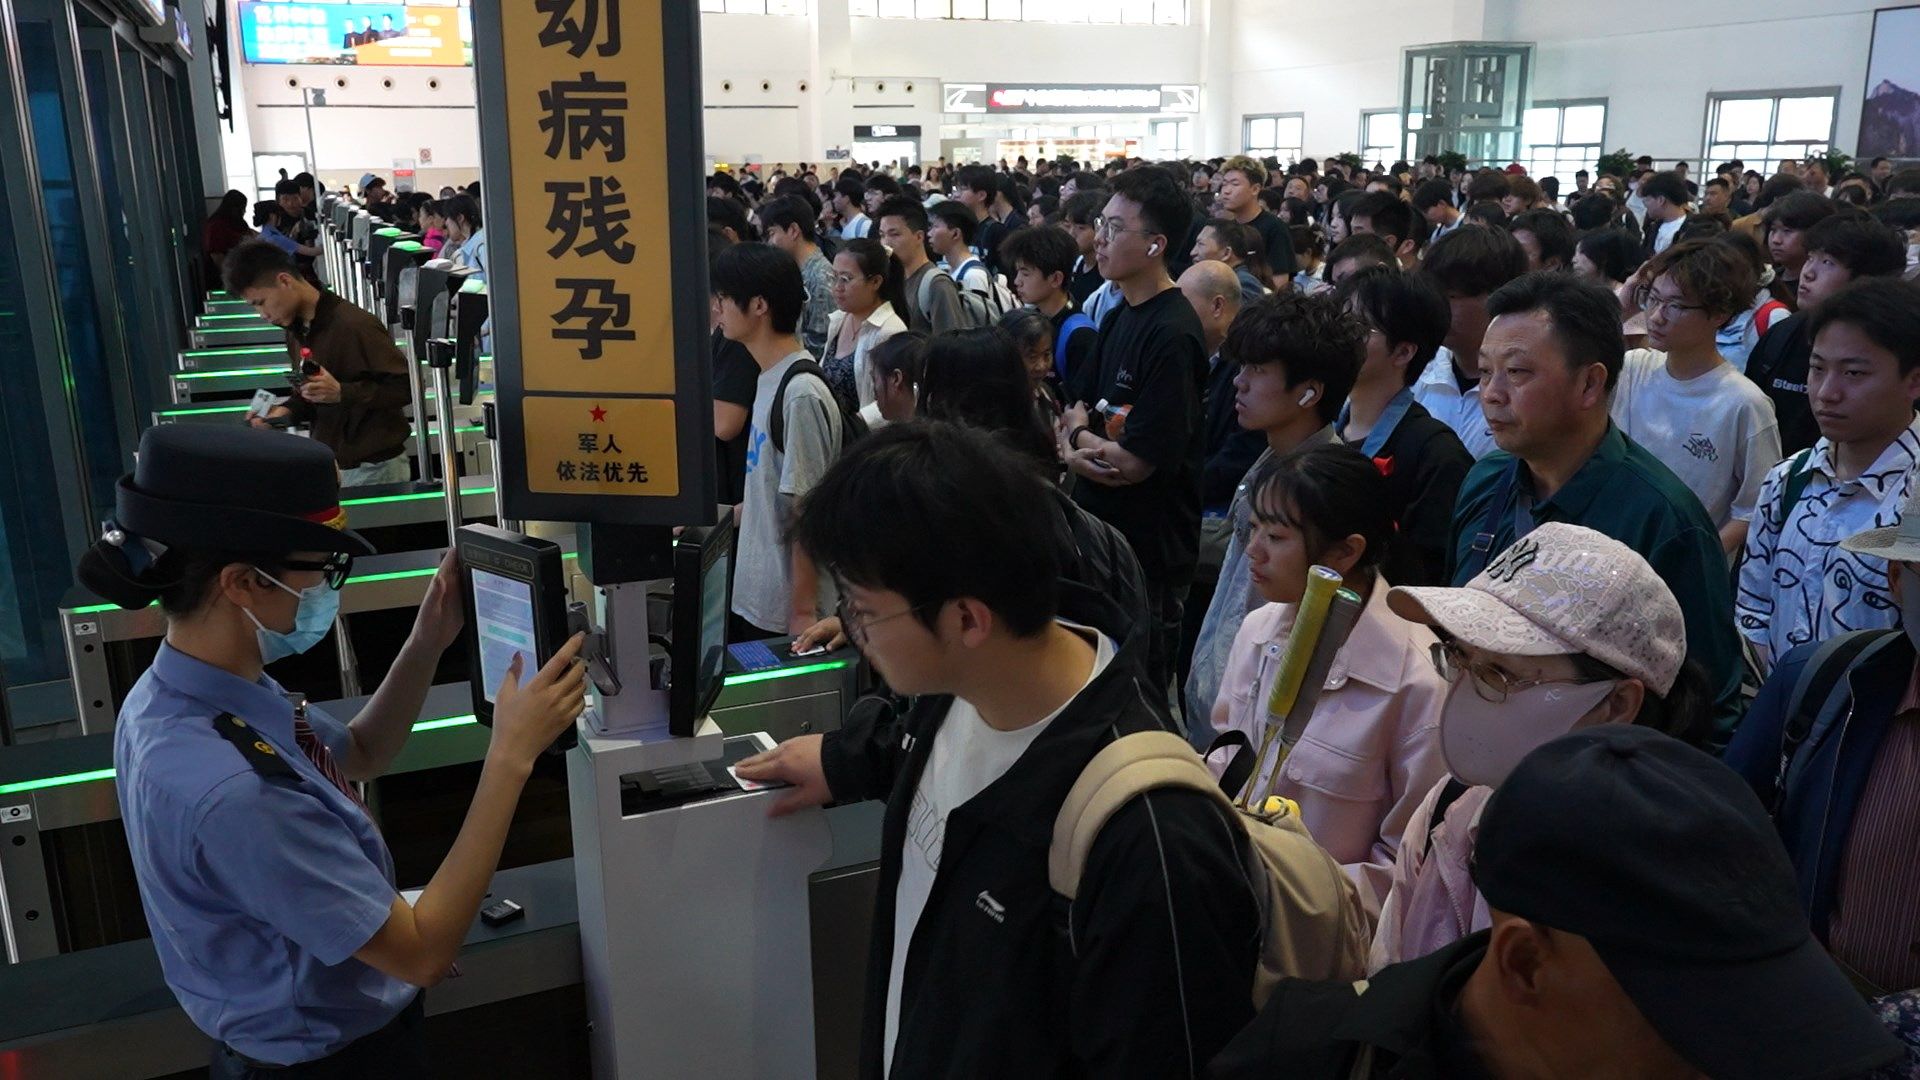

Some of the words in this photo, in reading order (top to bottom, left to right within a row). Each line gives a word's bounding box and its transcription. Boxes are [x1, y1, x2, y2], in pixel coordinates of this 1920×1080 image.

[535, 0, 637, 360] 幼病残孕
[578, 433, 623, 454] 军人
[556, 461, 649, 483] 依法优先
